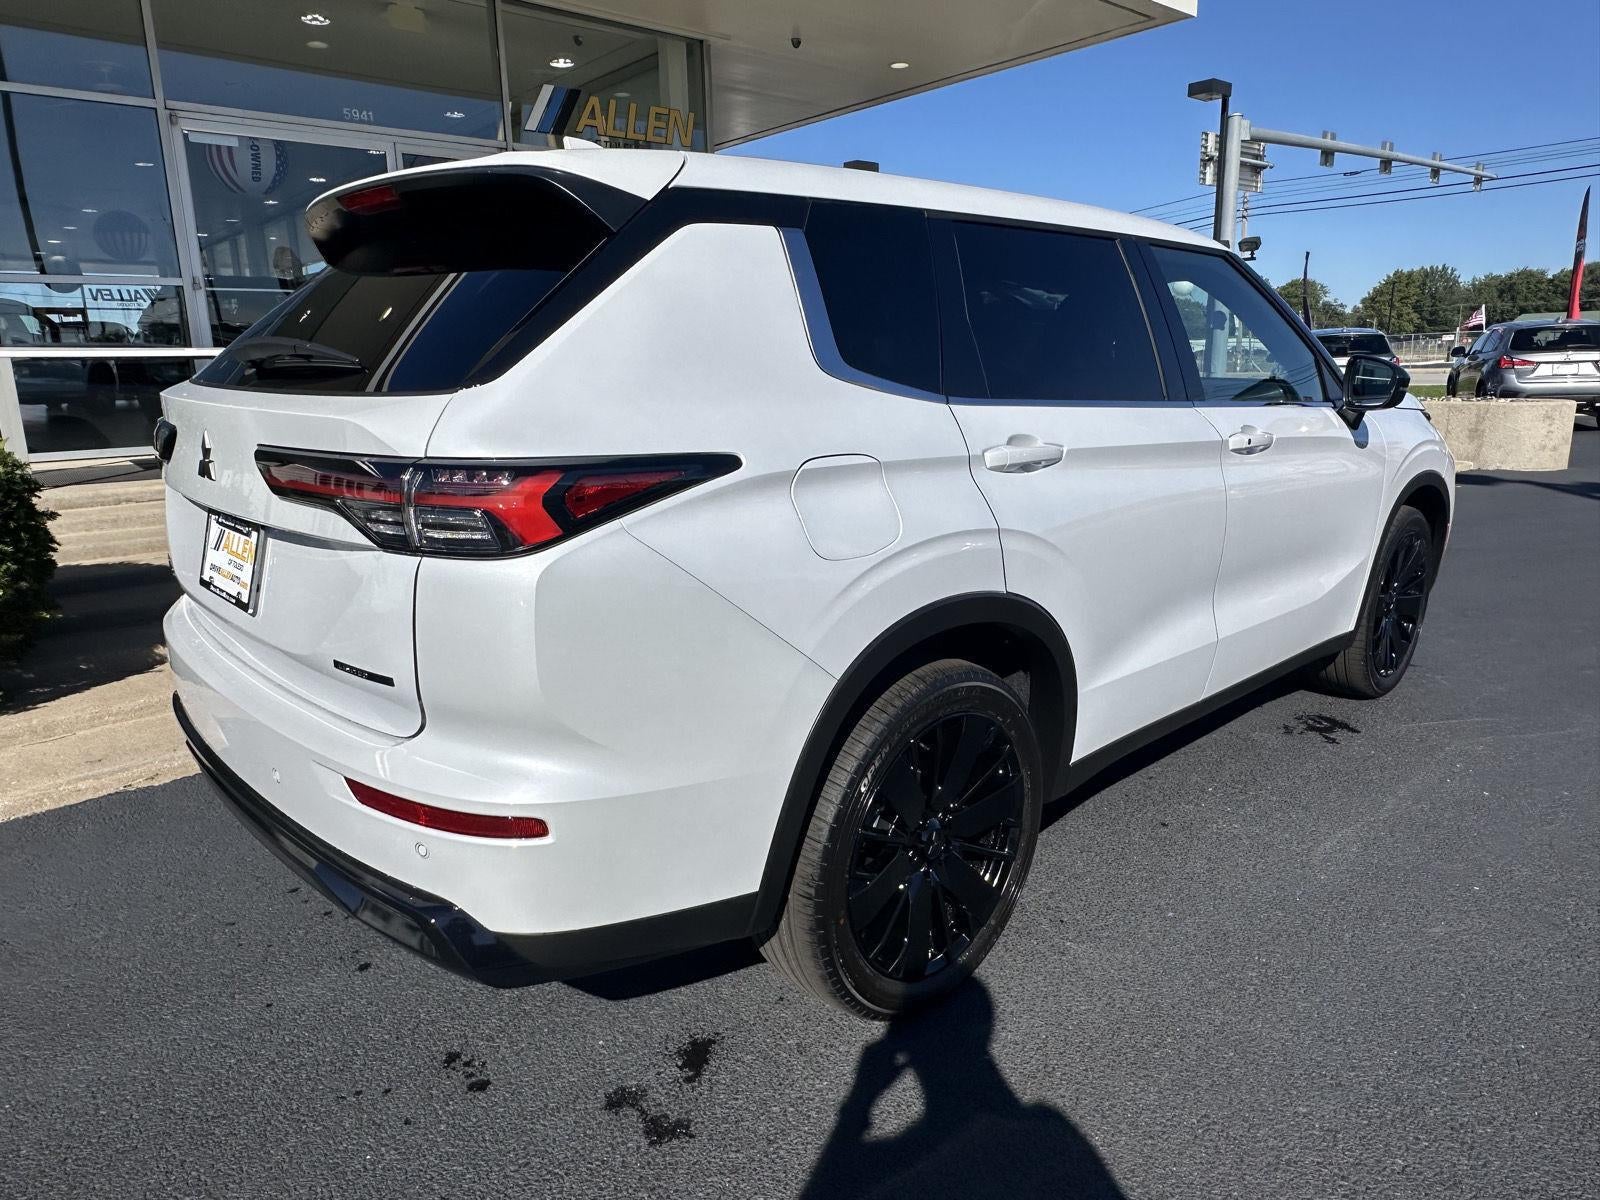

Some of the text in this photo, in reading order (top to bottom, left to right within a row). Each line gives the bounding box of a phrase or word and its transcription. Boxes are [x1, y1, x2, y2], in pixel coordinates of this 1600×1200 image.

[343, 107, 375, 121] 5941
[576, 95, 695, 147] ALLEN
[222, 531, 254, 565] ALLEN
